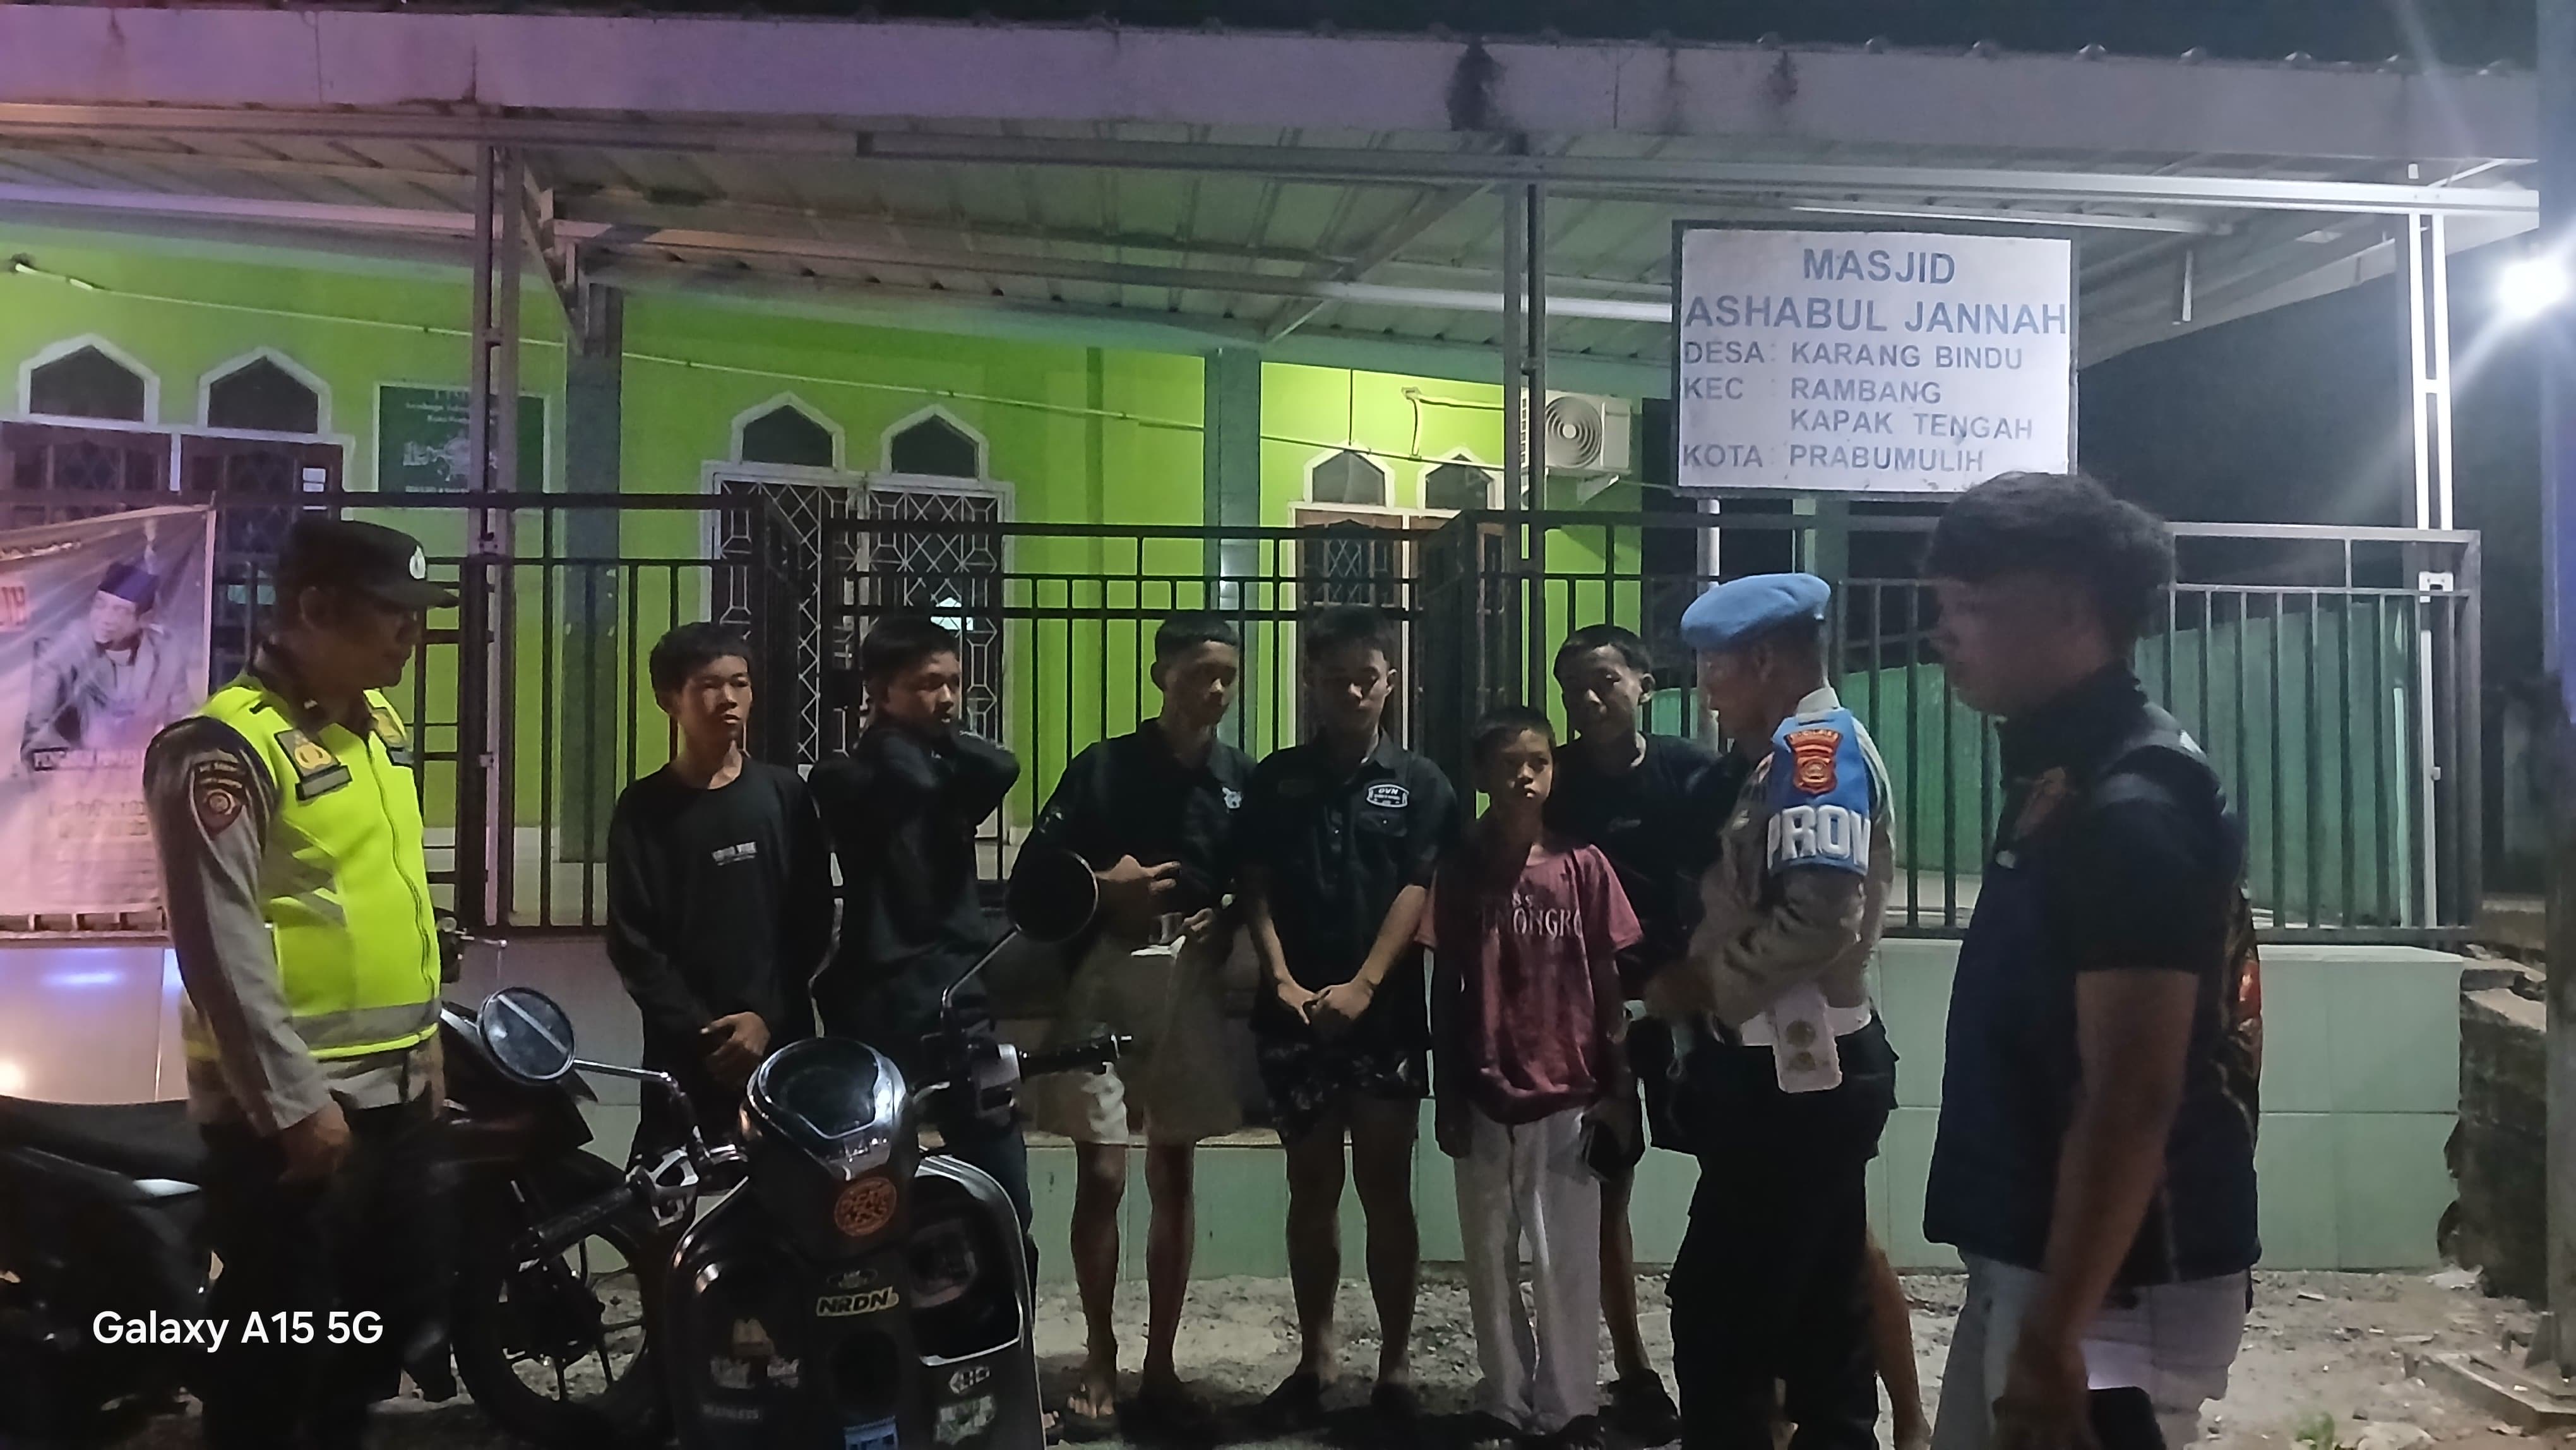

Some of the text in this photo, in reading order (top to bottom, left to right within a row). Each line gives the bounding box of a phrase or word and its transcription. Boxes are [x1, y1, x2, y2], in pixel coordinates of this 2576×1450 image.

[1803, 248, 1955, 284] MASJID
[1685, 295, 2066, 334] ASHABUL JANNAH
[1791, 342, 1921, 368] KARANG
[1935, 345, 2021, 369] BINDU
[1684, 377, 1743, 399] KEC
[1791, 377, 1941, 404] RAMBANG
[1791, 409, 2032, 440] KAPAK TENGAH
[1789, 445, 1983, 472] PRABUMULIH
